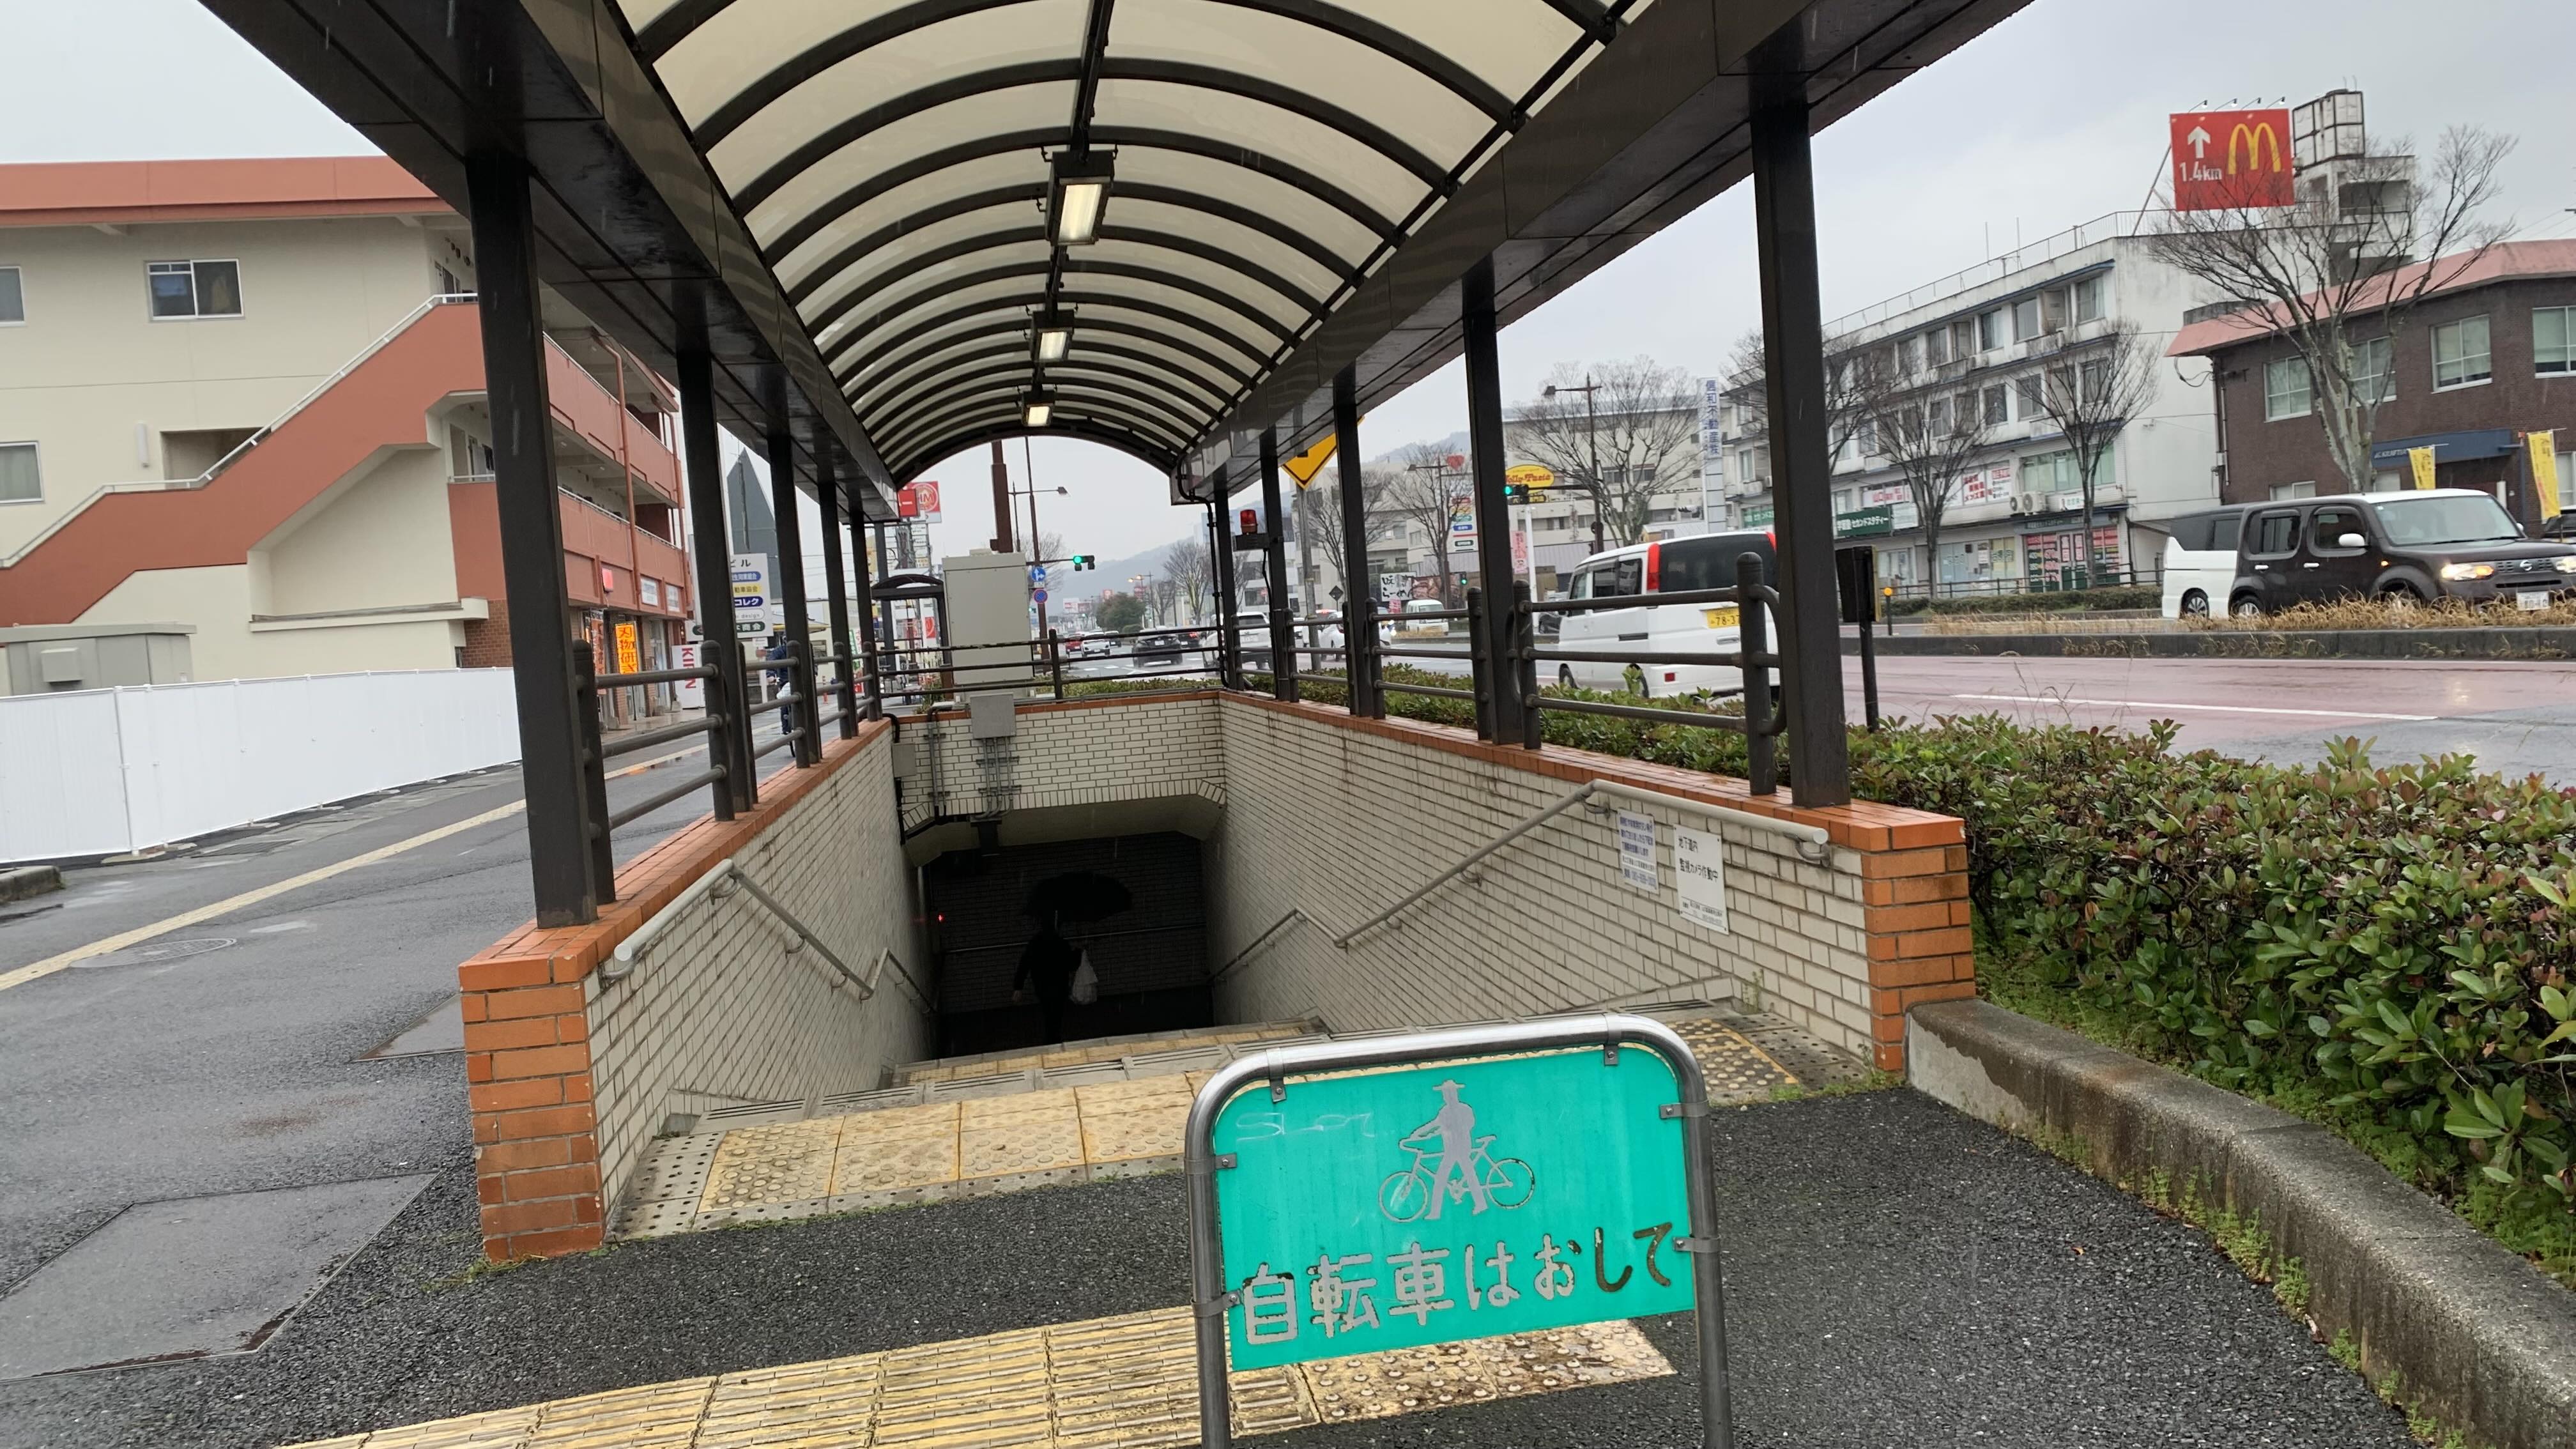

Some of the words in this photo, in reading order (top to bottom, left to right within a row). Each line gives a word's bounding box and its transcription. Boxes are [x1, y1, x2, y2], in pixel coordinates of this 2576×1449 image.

[2179, 161, 2222, 181] 1.4km
[682, 648, 696, 689] KIRN
[1679, 857, 1718, 882] 監視カメラ作動中
[1242, 1221, 1673, 1346] 自転車はおして
